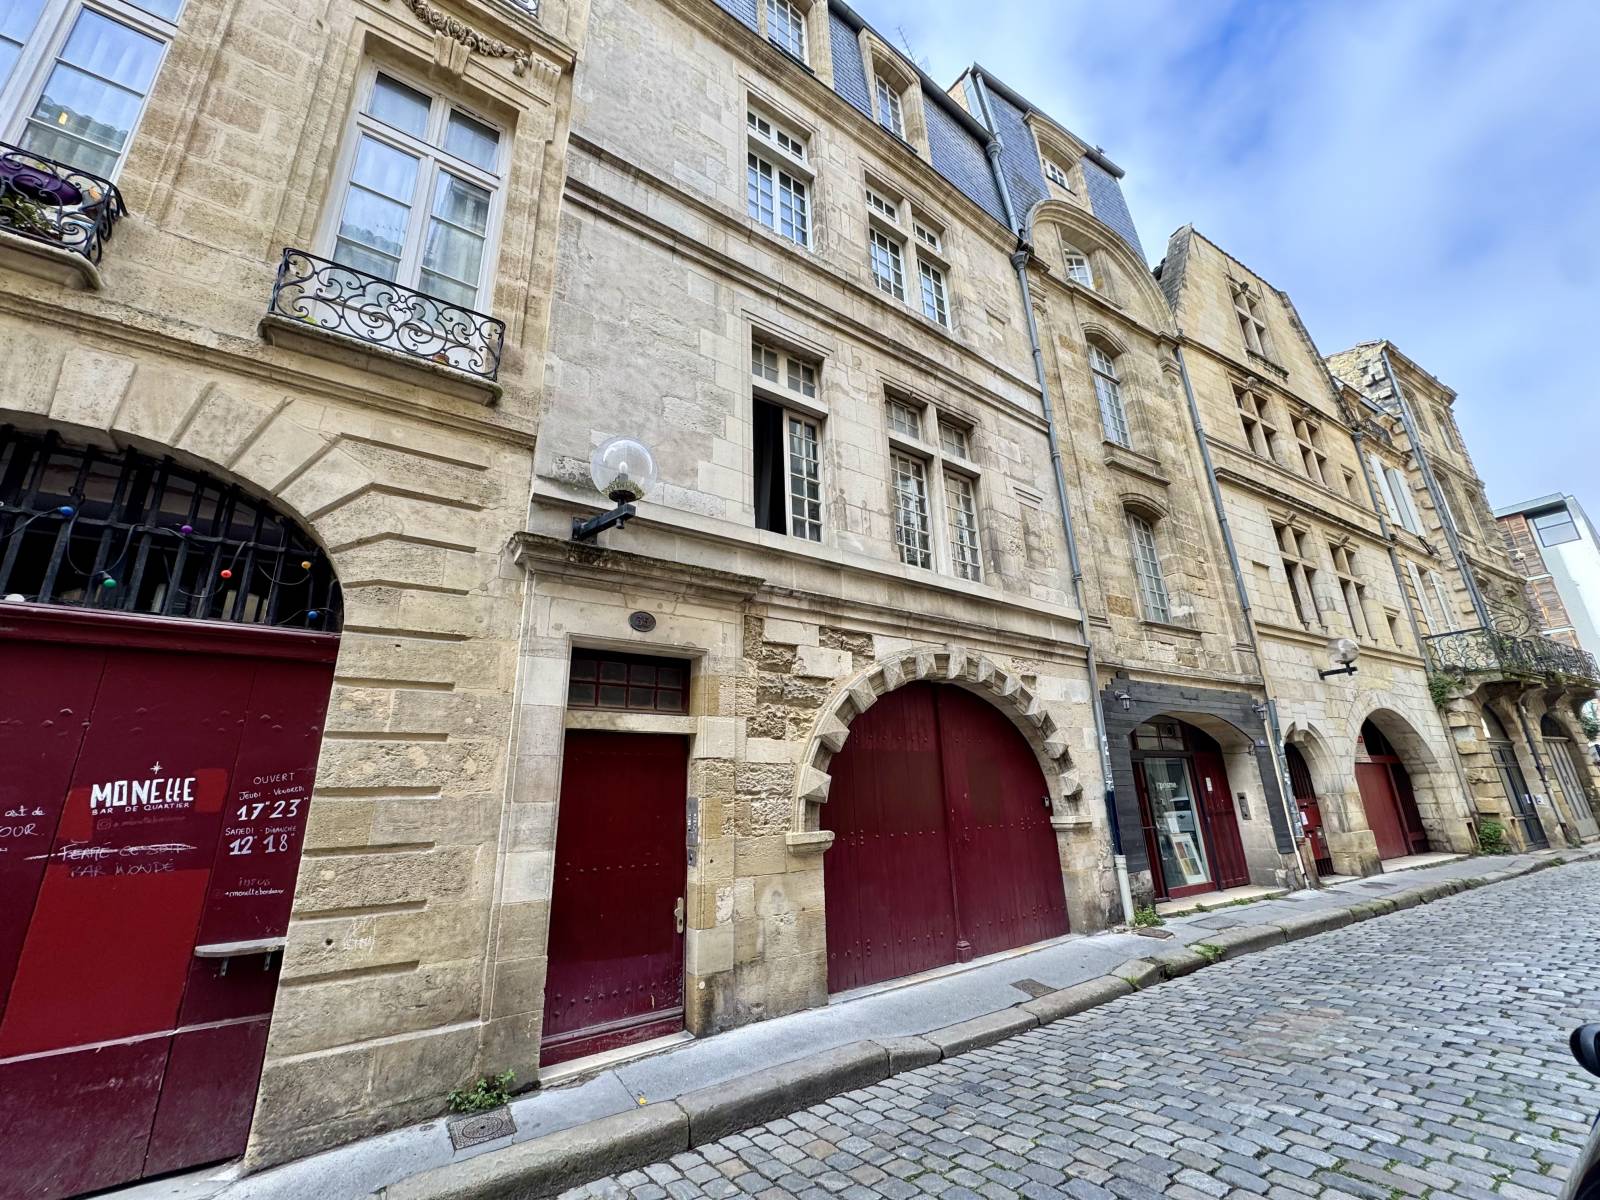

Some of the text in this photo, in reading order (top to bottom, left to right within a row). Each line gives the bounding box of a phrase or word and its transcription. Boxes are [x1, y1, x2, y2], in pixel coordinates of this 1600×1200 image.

[253, 772, 295, 785] OUVERT
[90, 777, 196, 809] MONELLE
[91, 802, 190, 816] BAR DE QUARTIER
[225, 827, 254, 836] SAMEDI
